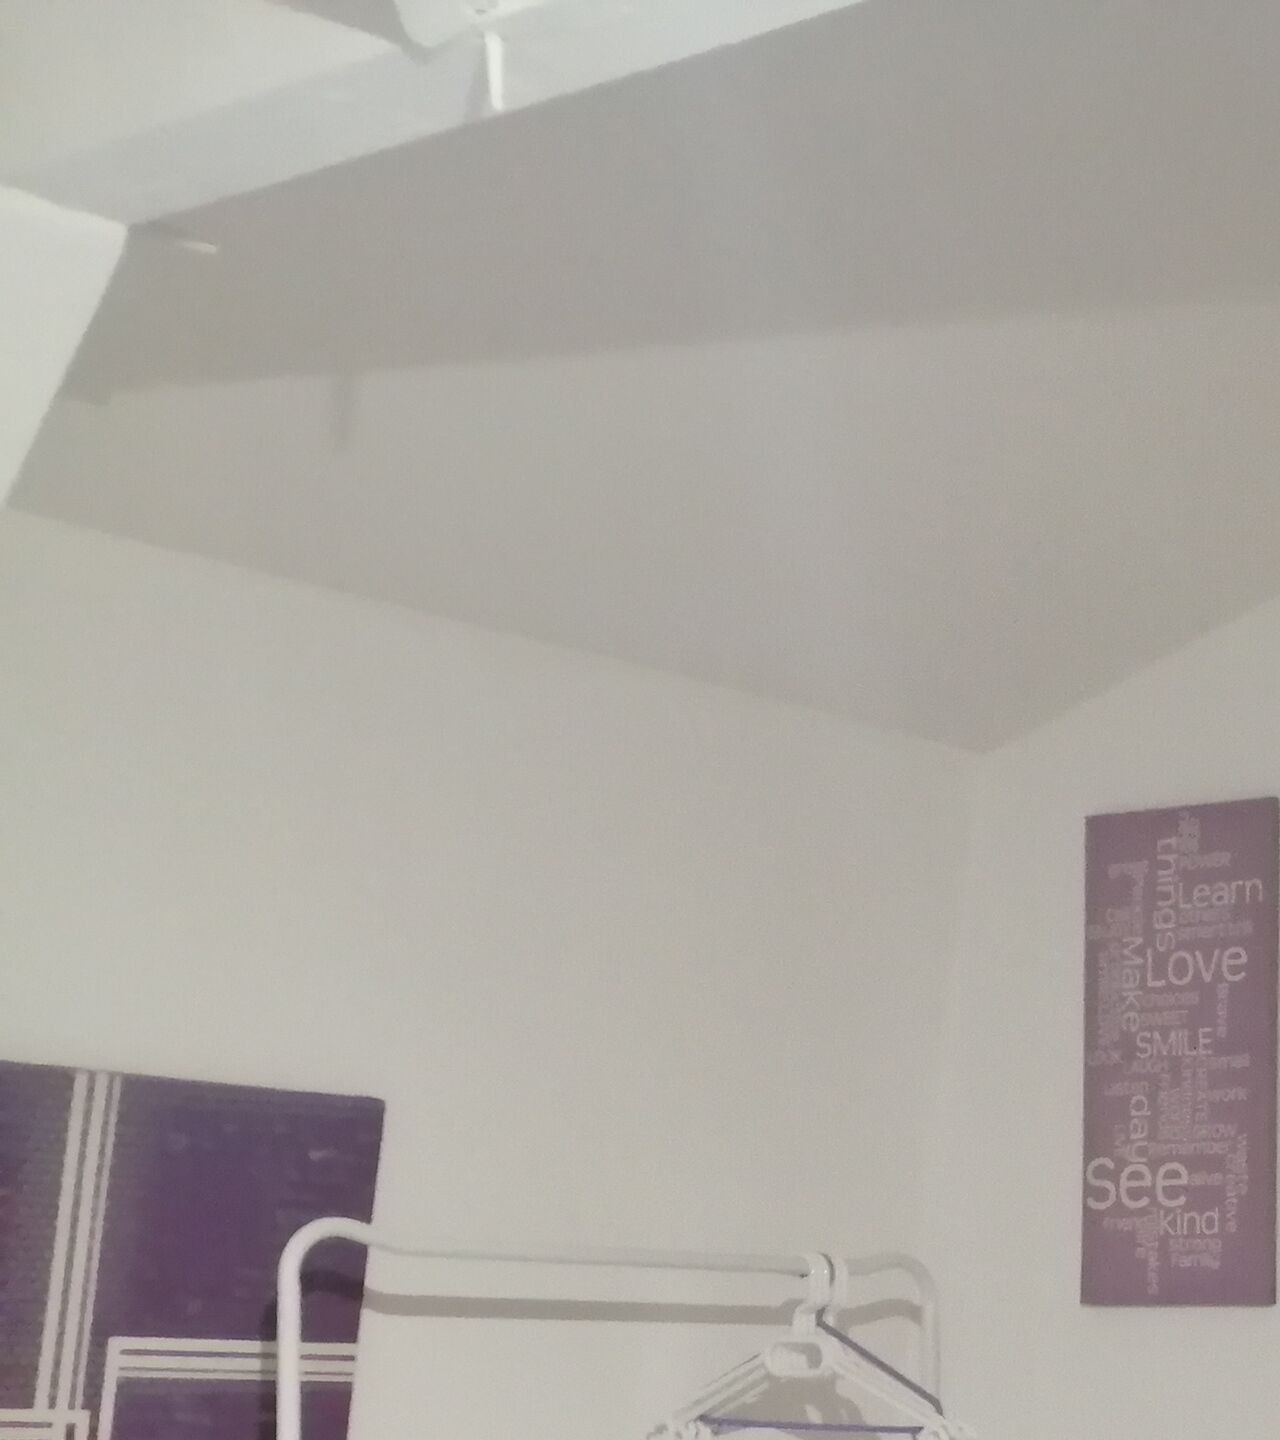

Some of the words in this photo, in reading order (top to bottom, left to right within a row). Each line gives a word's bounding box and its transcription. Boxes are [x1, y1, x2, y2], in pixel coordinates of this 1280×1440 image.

[1178, 878, 1263, 909] Learn
[1121, 937, 1144, 1033] Make
[1146, 946, 1249, 988] Love
[1136, 1027, 1213, 1058] SMILE
[1127, 1094, 1151, 1163] day
[1085, 1156, 1190, 1210] See
[1159, 1207, 1219, 1235] kind
